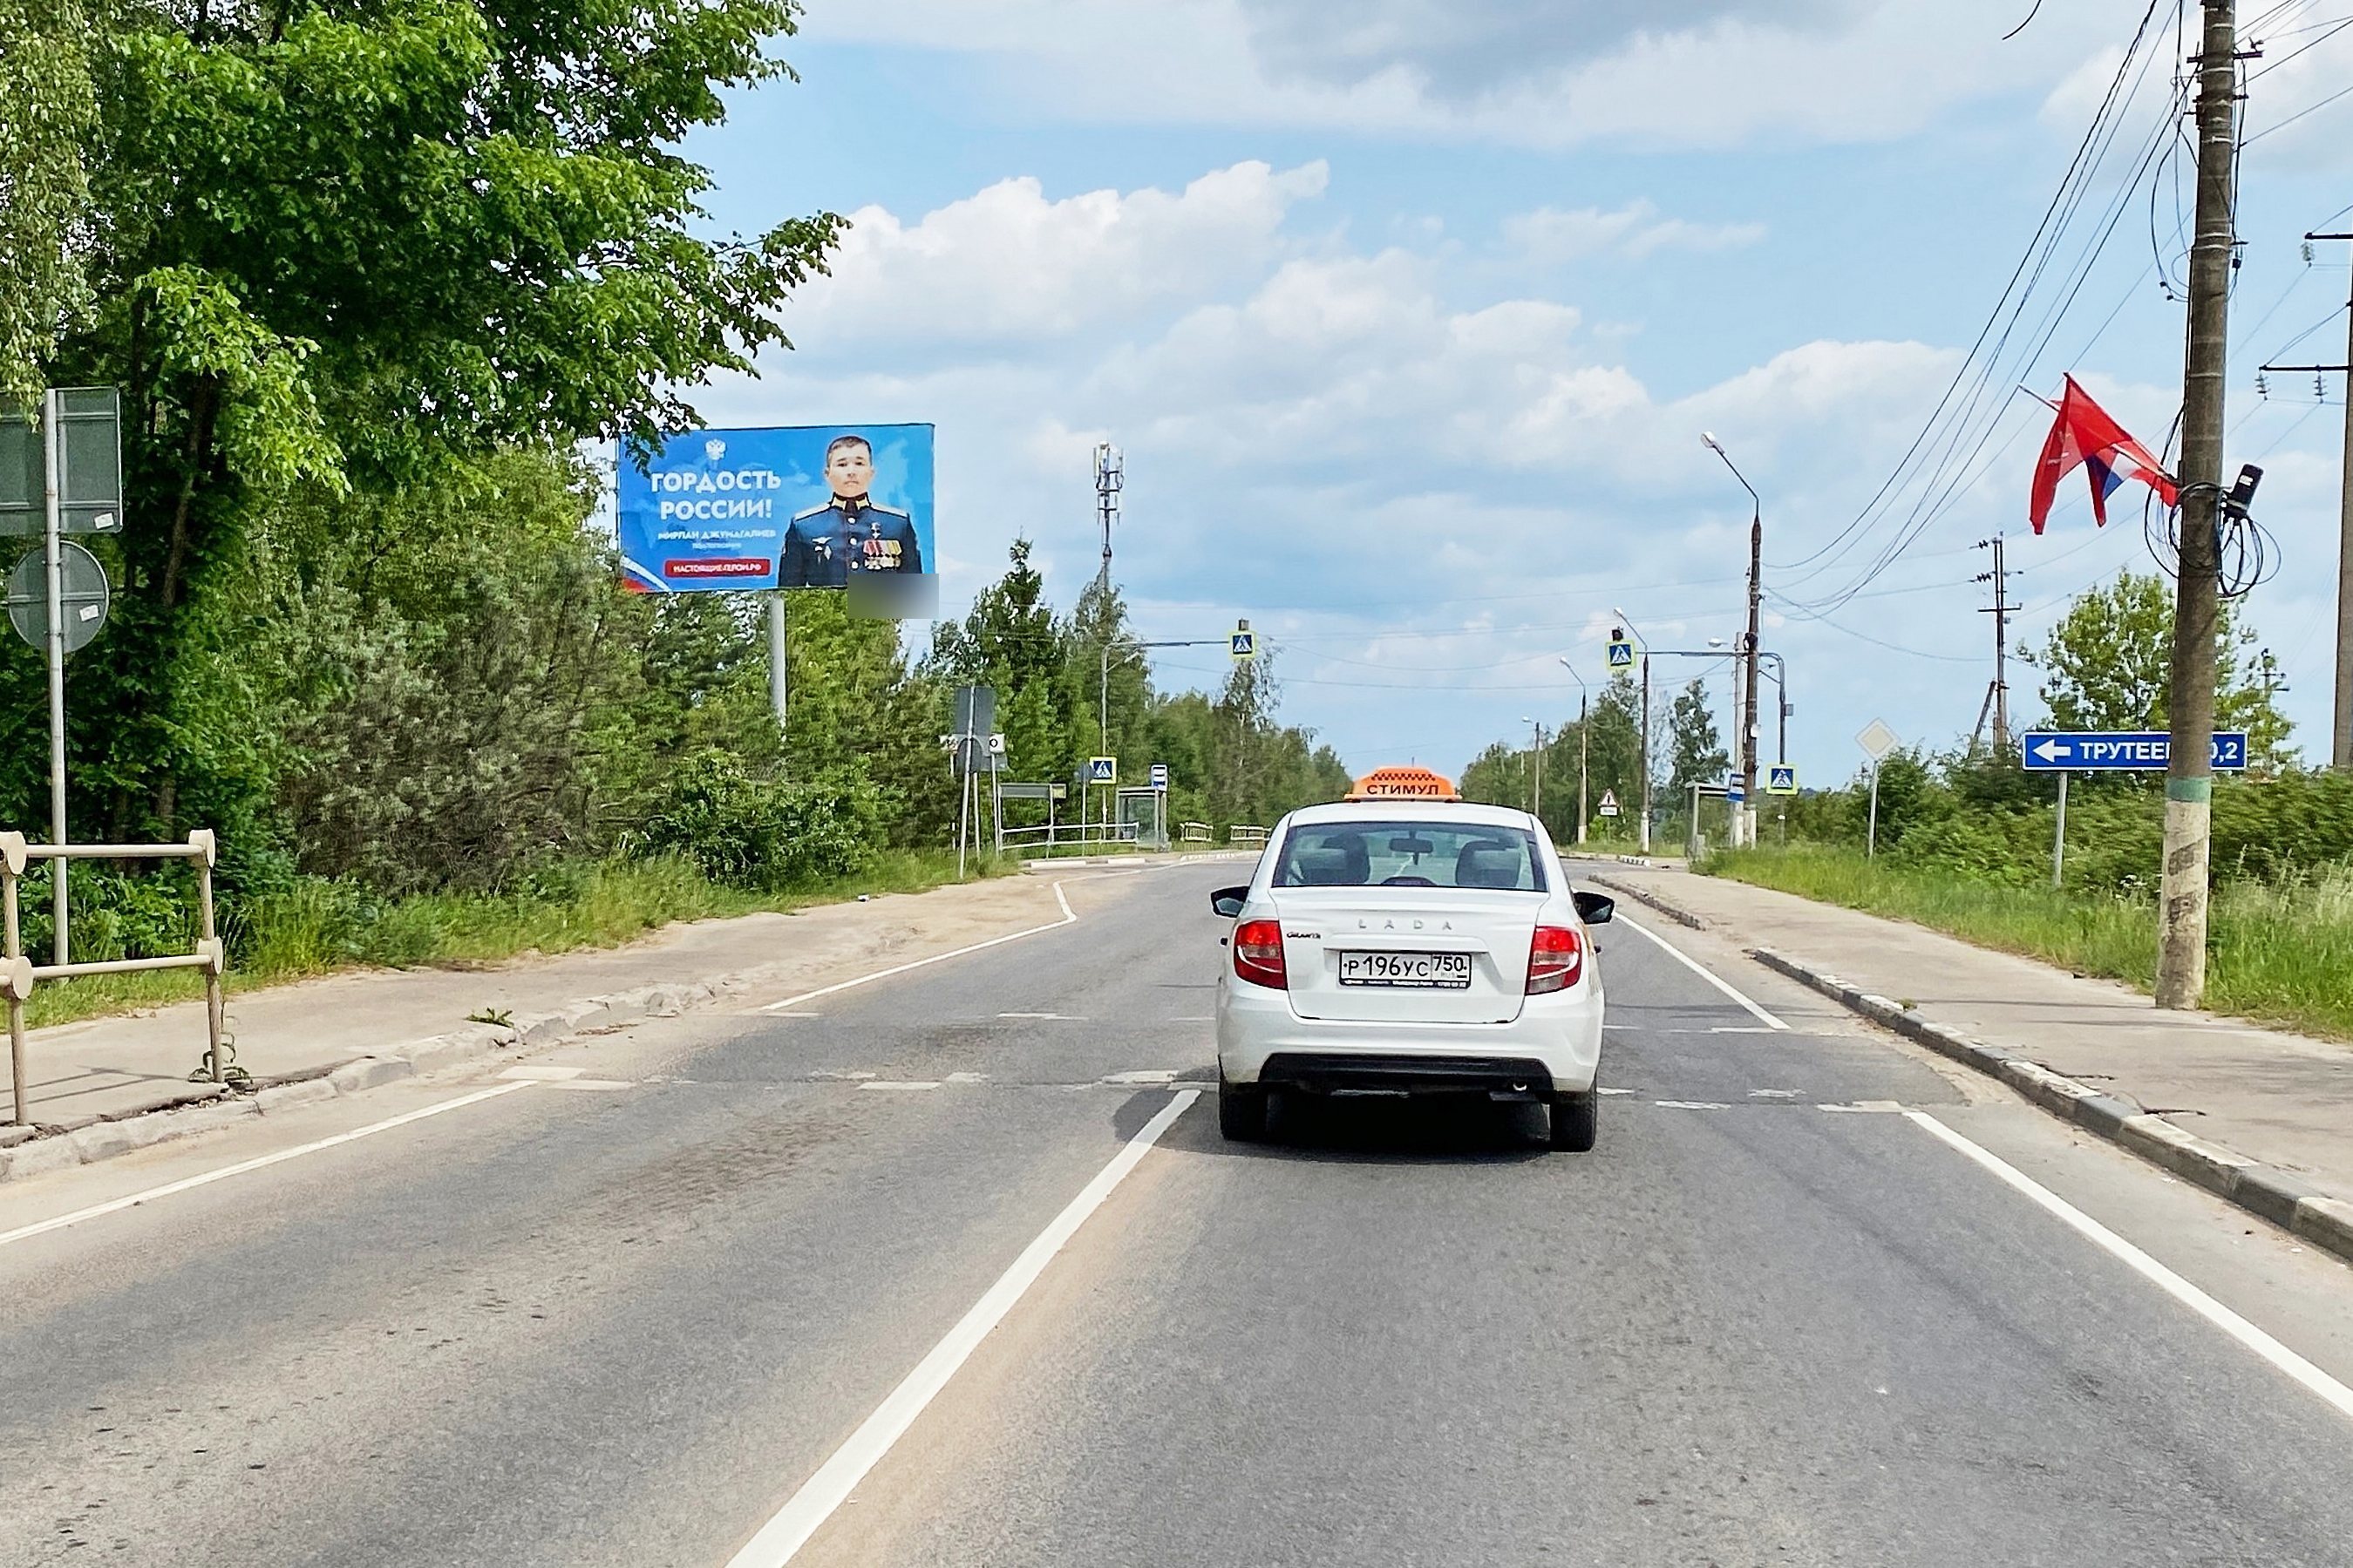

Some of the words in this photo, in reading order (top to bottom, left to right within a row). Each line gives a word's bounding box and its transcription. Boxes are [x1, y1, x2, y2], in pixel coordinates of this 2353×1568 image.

[651, 470, 781, 493] ГОРДОСТЬ
[660, 499, 772, 520] РОССИИ!
[2079, 742, 2171, 760] ТРУТЕЕ
[1366, 784, 1439, 796] СТИМУЛ
[1358, 919, 1452, 931] LADA
[1433, 955, 1464, 972] 750
